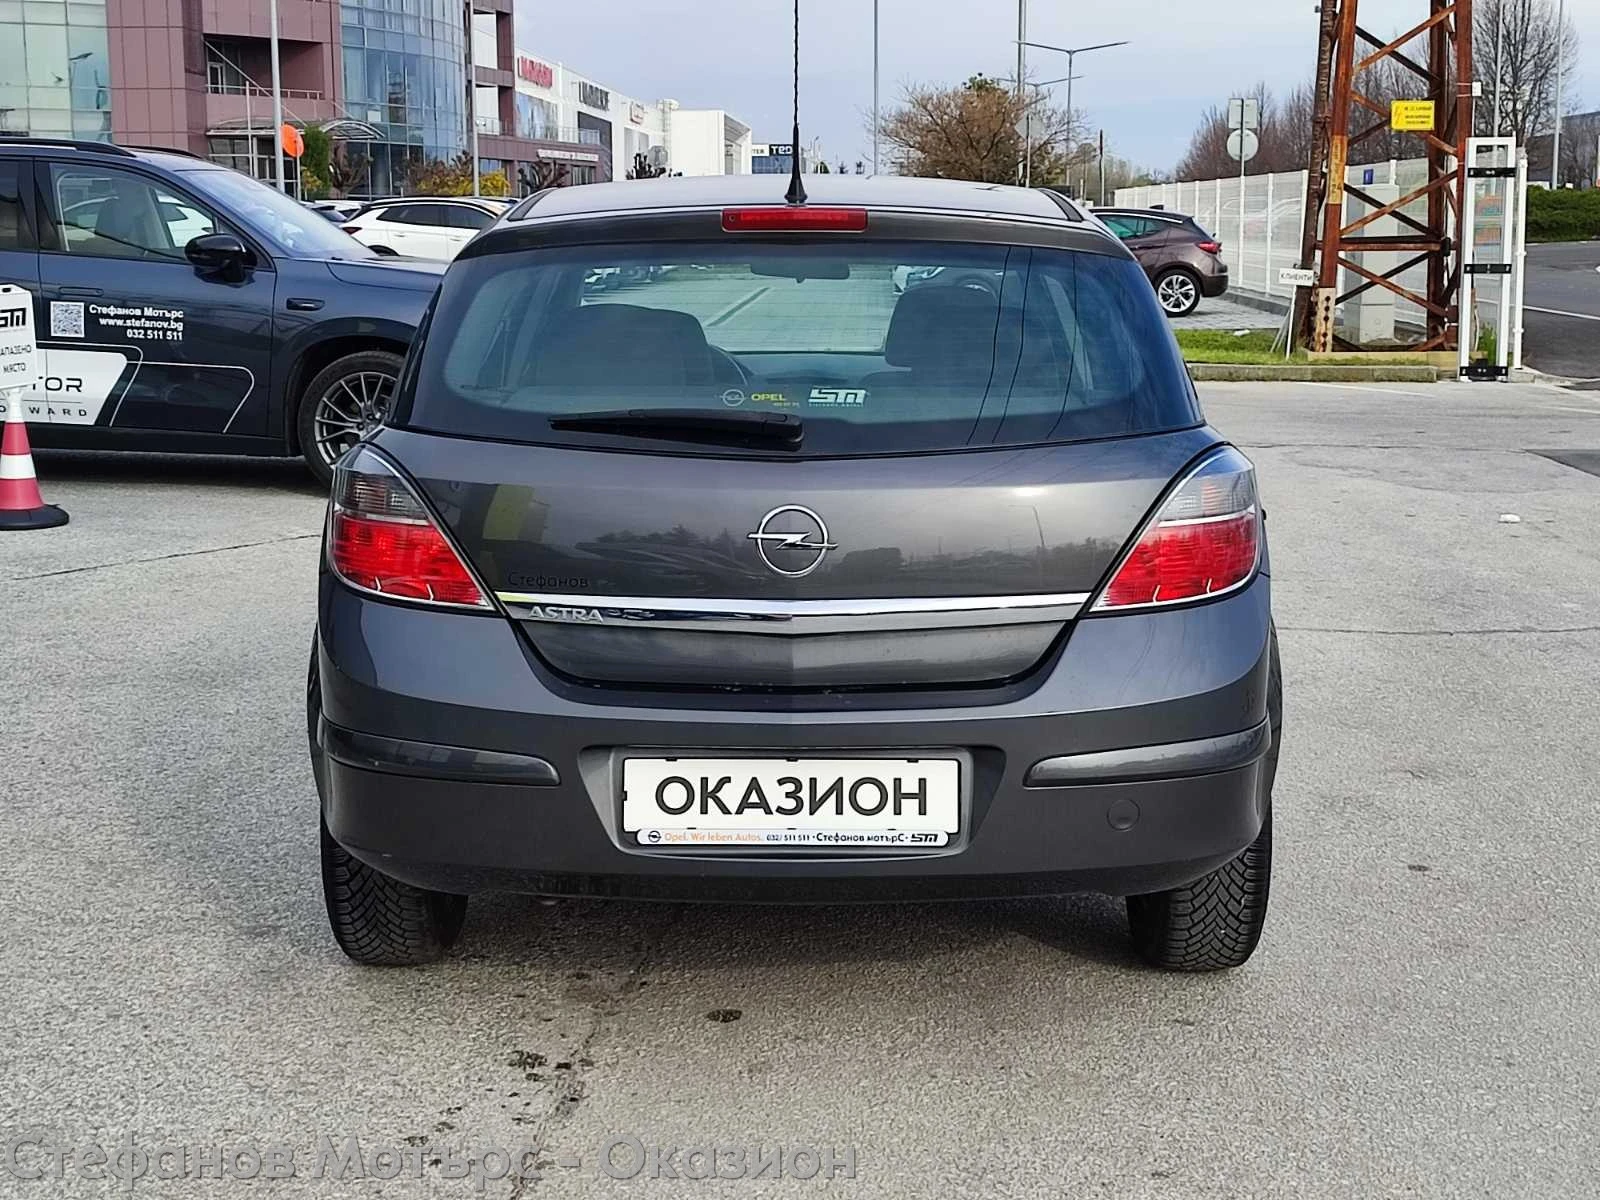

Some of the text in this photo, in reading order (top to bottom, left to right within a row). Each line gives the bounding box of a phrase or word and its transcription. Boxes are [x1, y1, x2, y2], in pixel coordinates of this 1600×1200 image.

[89, 304, 184, 319] Стефанов Мотърс
[99, 318, 184, 331] www.stefanov.bg
[126, 329, 183, 341] 032 511 511
[0, 344, 32, 356] АПАЗЕНО
[508, 573, 588, 588] Стефанов
[529, 606, 603, 622] ASTRA
[655, 776, 928, 816] ОКАЗИОН
[691, 833, 705, 841] Wir
[708, 833, 732, 841] leben
[816, 832, 864, 843] Стефанов
